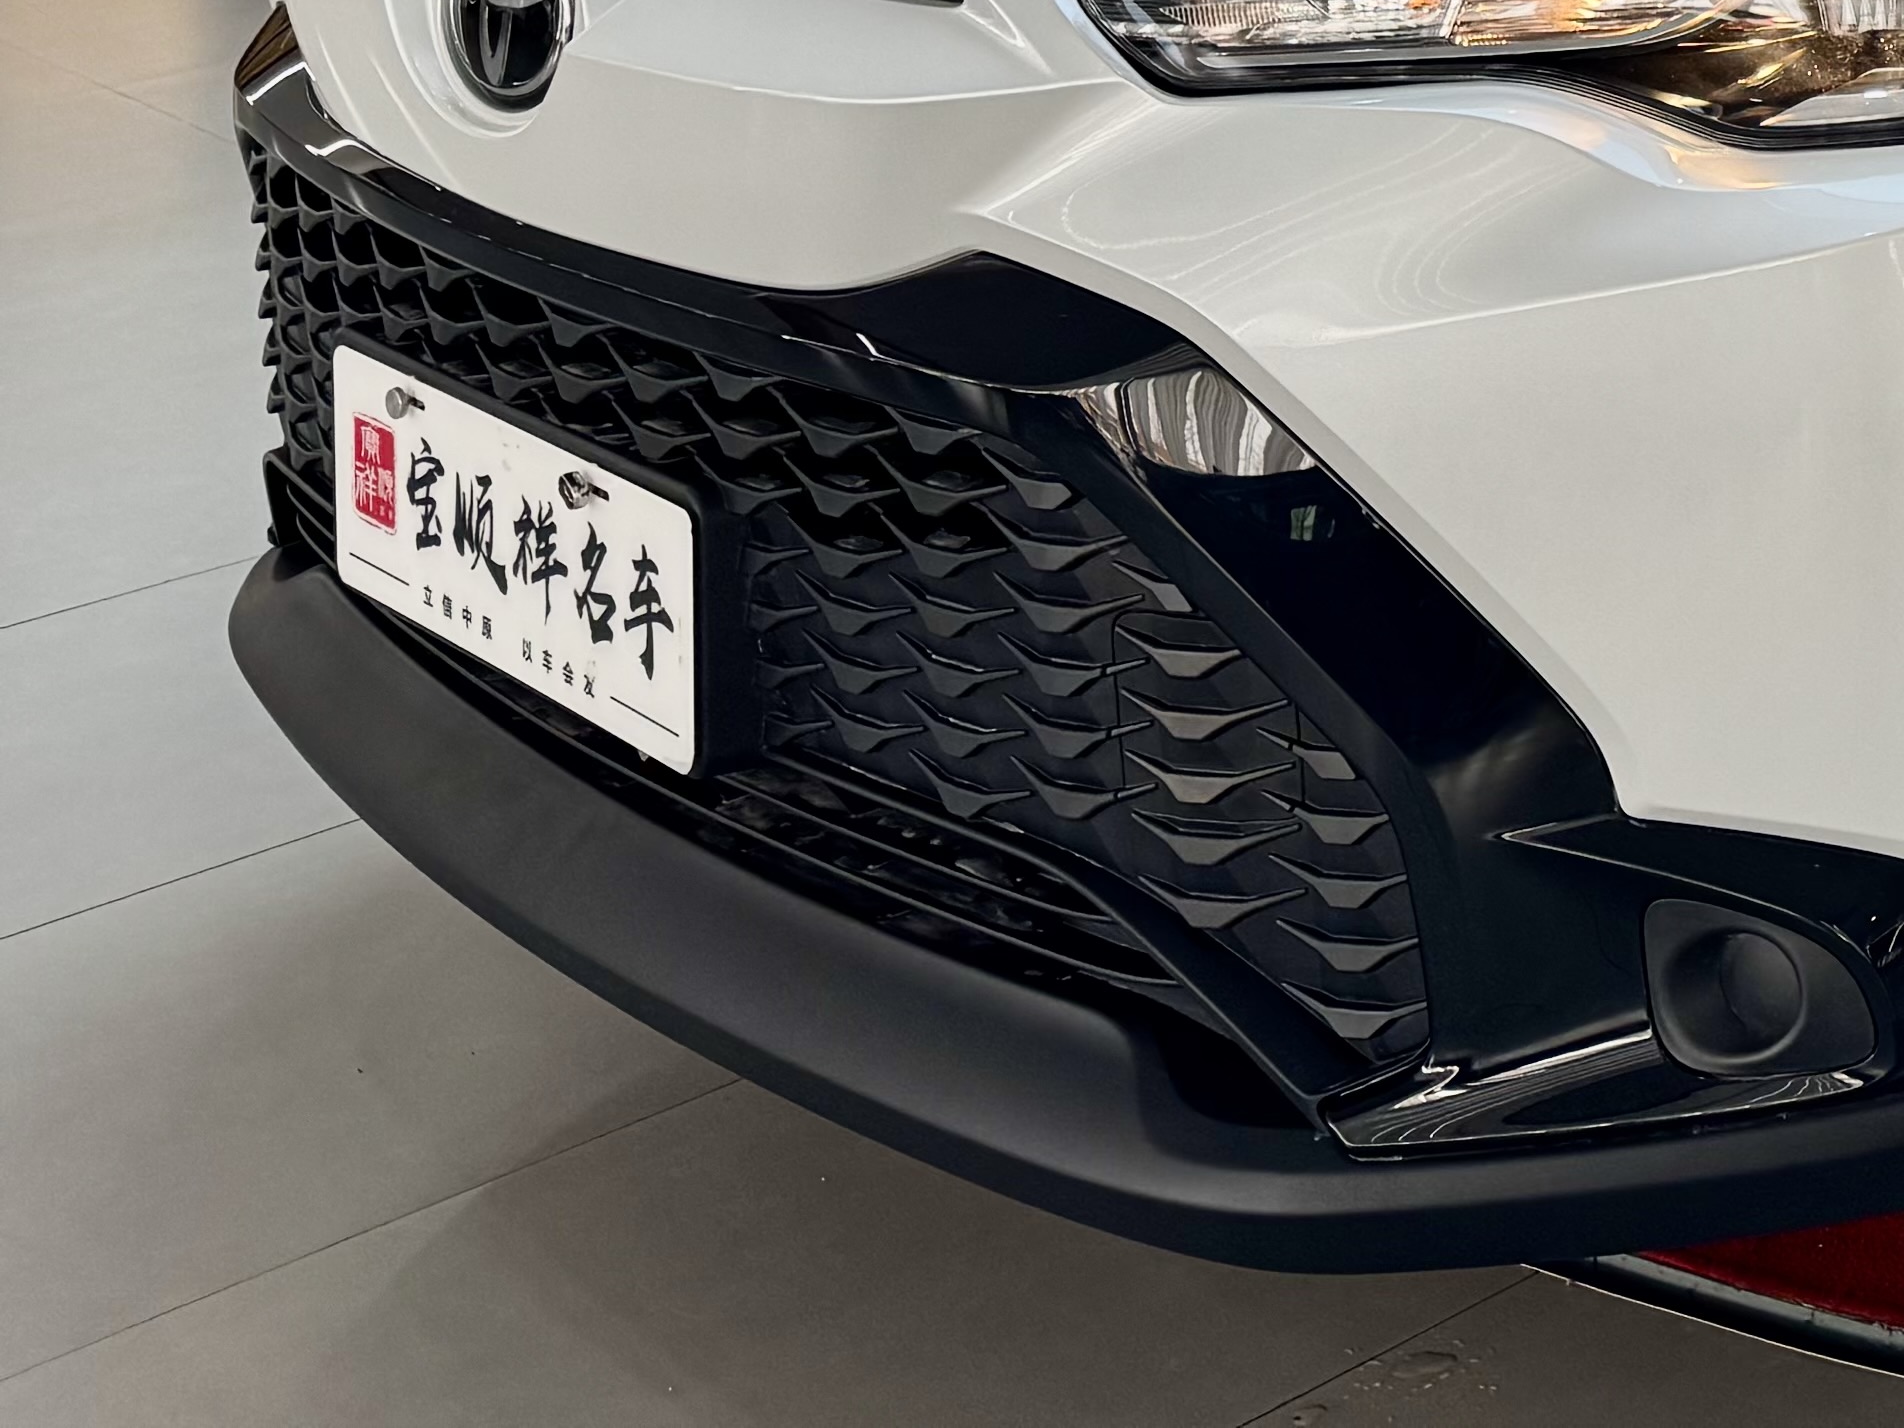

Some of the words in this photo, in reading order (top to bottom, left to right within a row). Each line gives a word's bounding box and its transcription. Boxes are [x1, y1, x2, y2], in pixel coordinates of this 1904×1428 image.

[406, 438, 675, 681] 宝顺祥名车
